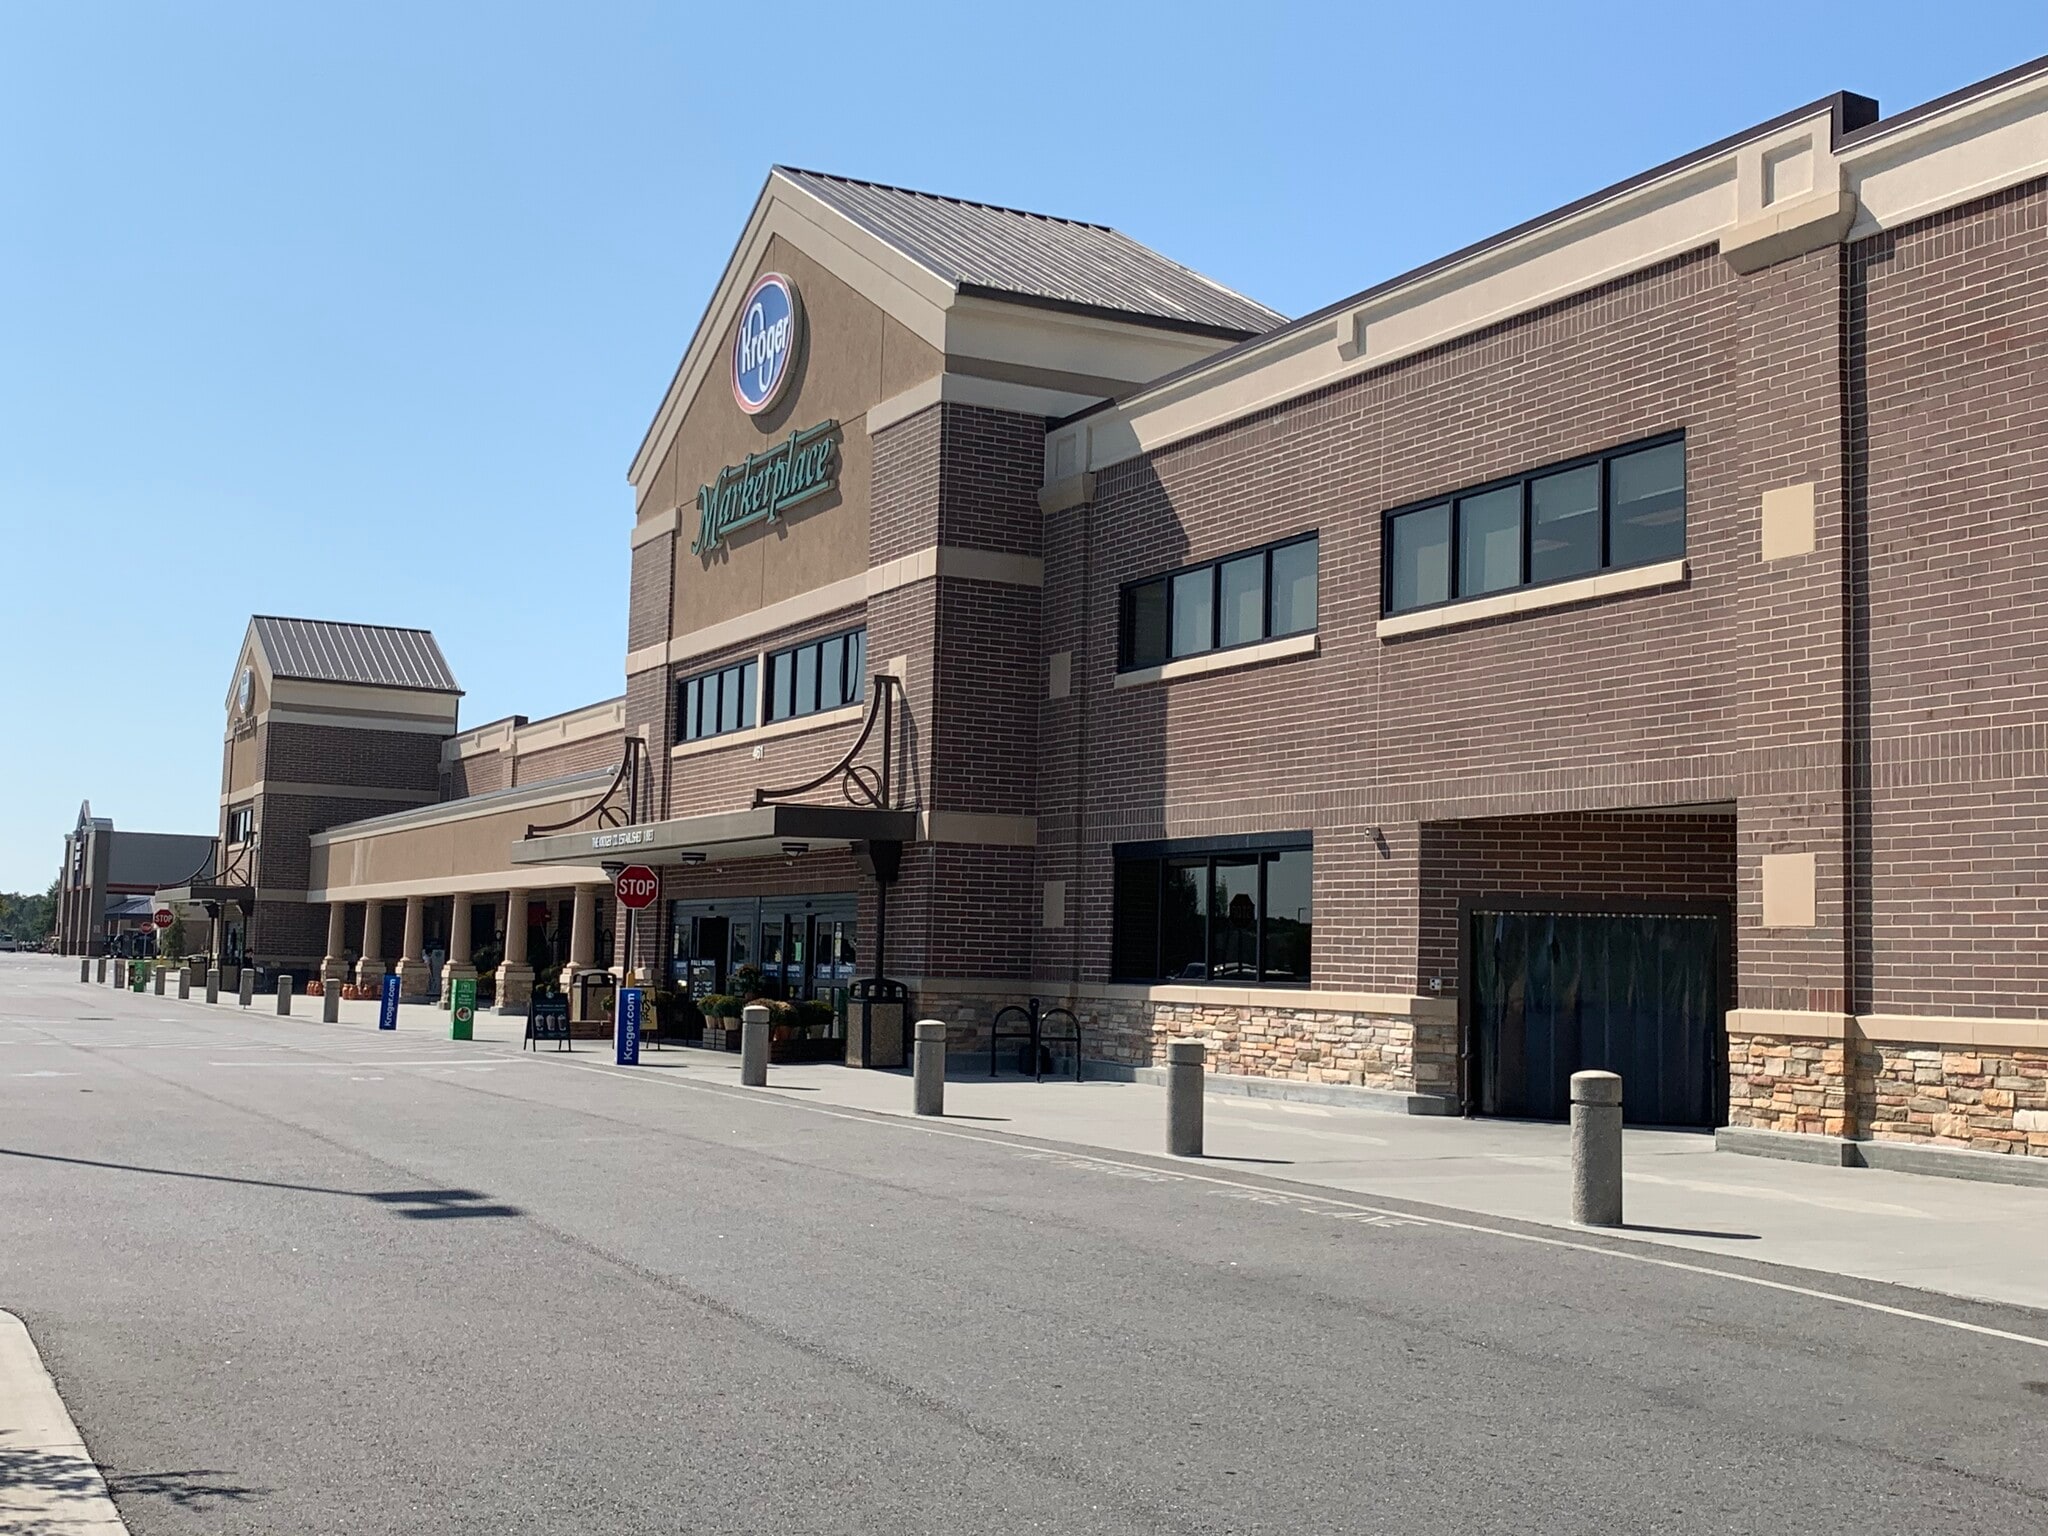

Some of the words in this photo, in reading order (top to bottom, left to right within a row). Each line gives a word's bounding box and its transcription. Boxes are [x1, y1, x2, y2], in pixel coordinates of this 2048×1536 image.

[741, 302, 790, 394] Kroger
[691, 429, 834, 556] Marketplace
[618, 878, 656, 896] STOP
[155, 914, 173, 923] STOP
[384, 978, 397, 1027] Kroger.com
[623, 993, 636, 1060] Kroger.com
